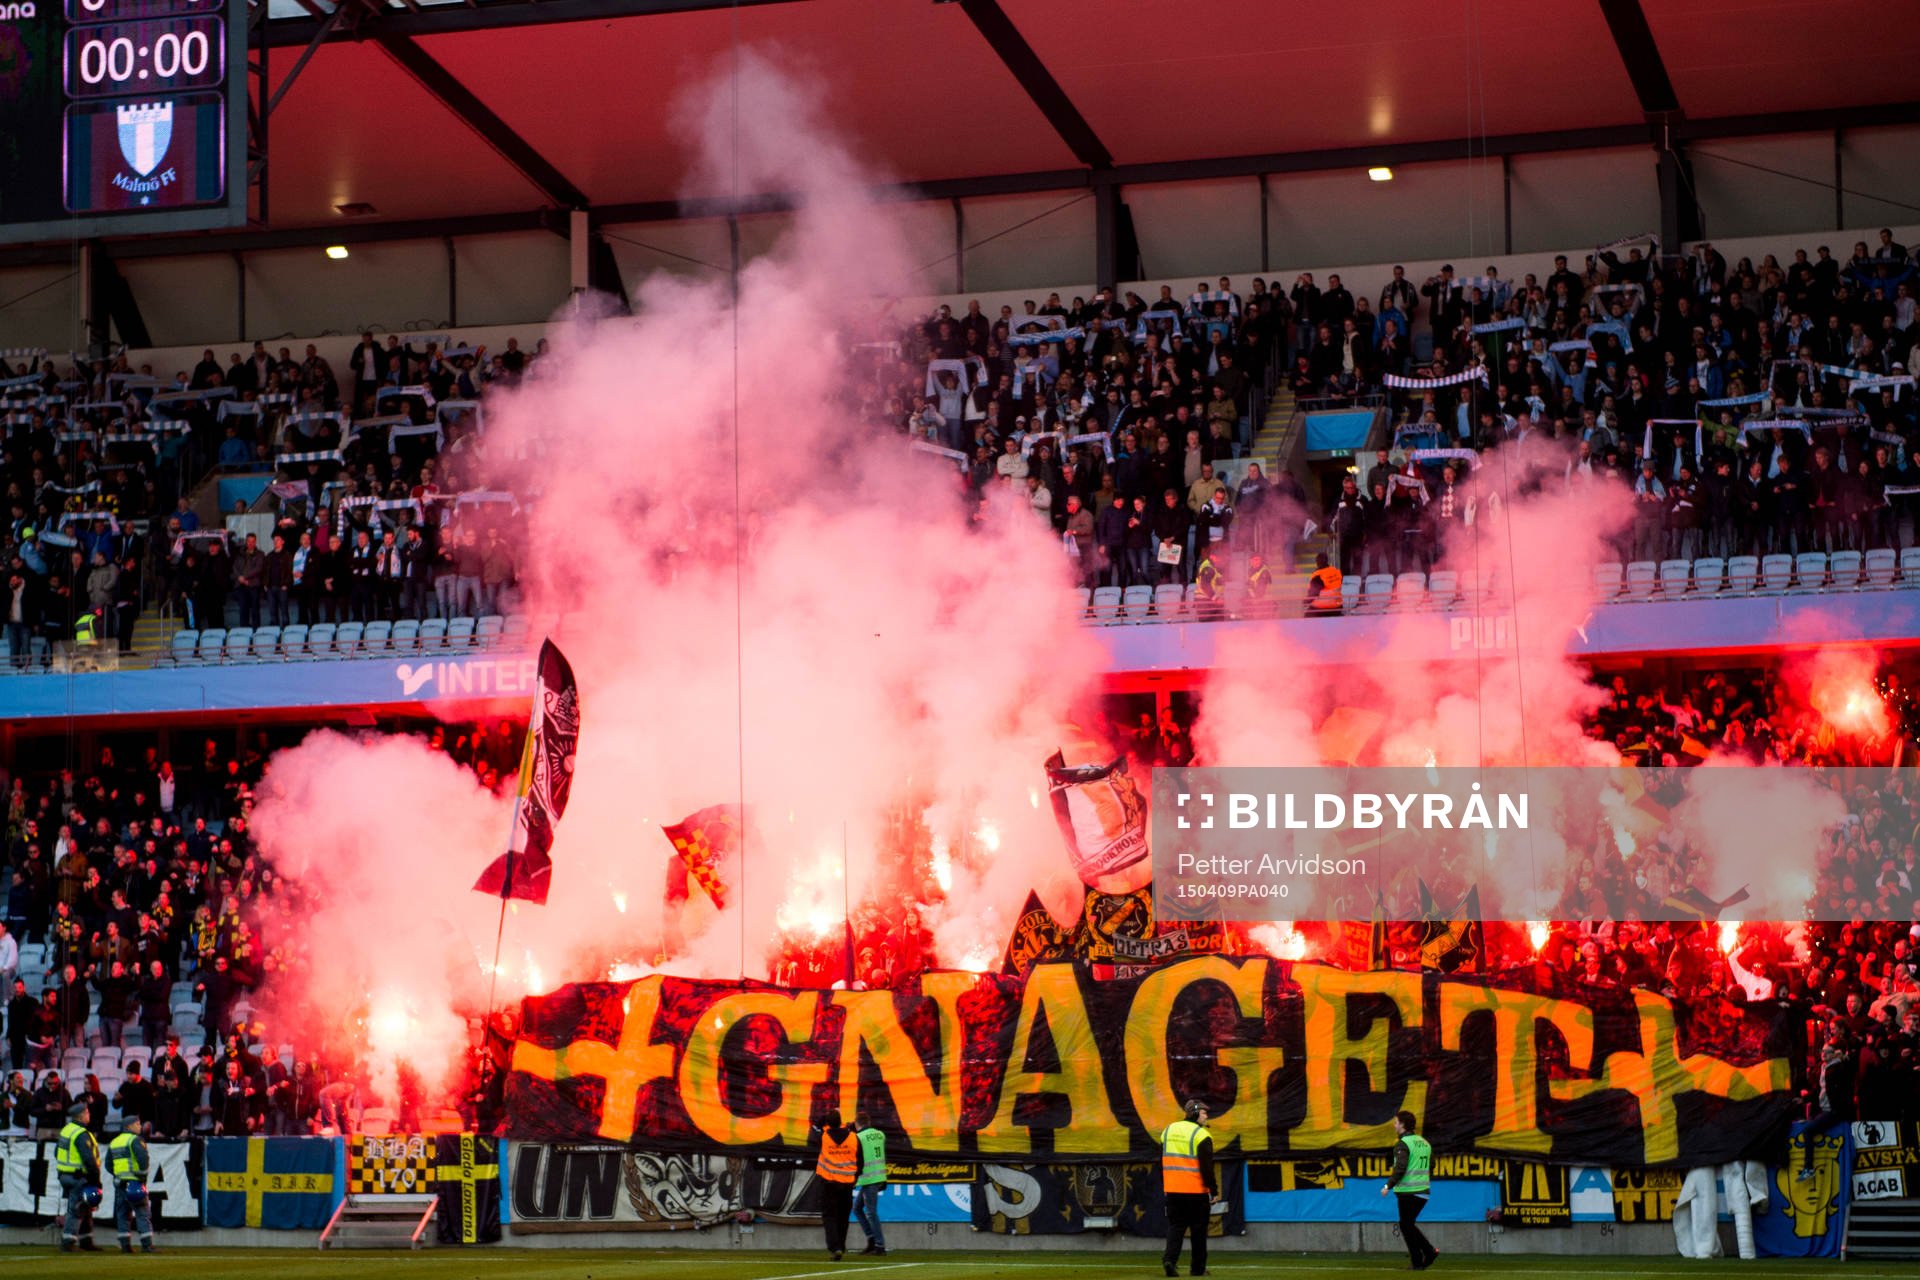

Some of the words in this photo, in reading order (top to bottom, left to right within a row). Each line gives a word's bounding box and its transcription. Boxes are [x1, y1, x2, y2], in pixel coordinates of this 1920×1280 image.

[80, 31, 209, 84] 00:00
[112, 172, 160, 193] Malmö
[160, 168, 177, 187] FF
[1114, 934, 1188, 957] ULTRAS
[679, 954, 1594, 1153] GNAGET
[461, 1138, 474, 1178] Glada
[377, 1167, 417, 1189] 170
[1857, 1179, 1899, 1195] ACAB
[1520, 1207, 1570, 1216] STOCKHOLM
[1600, 1224, 1615, 1237] 84
